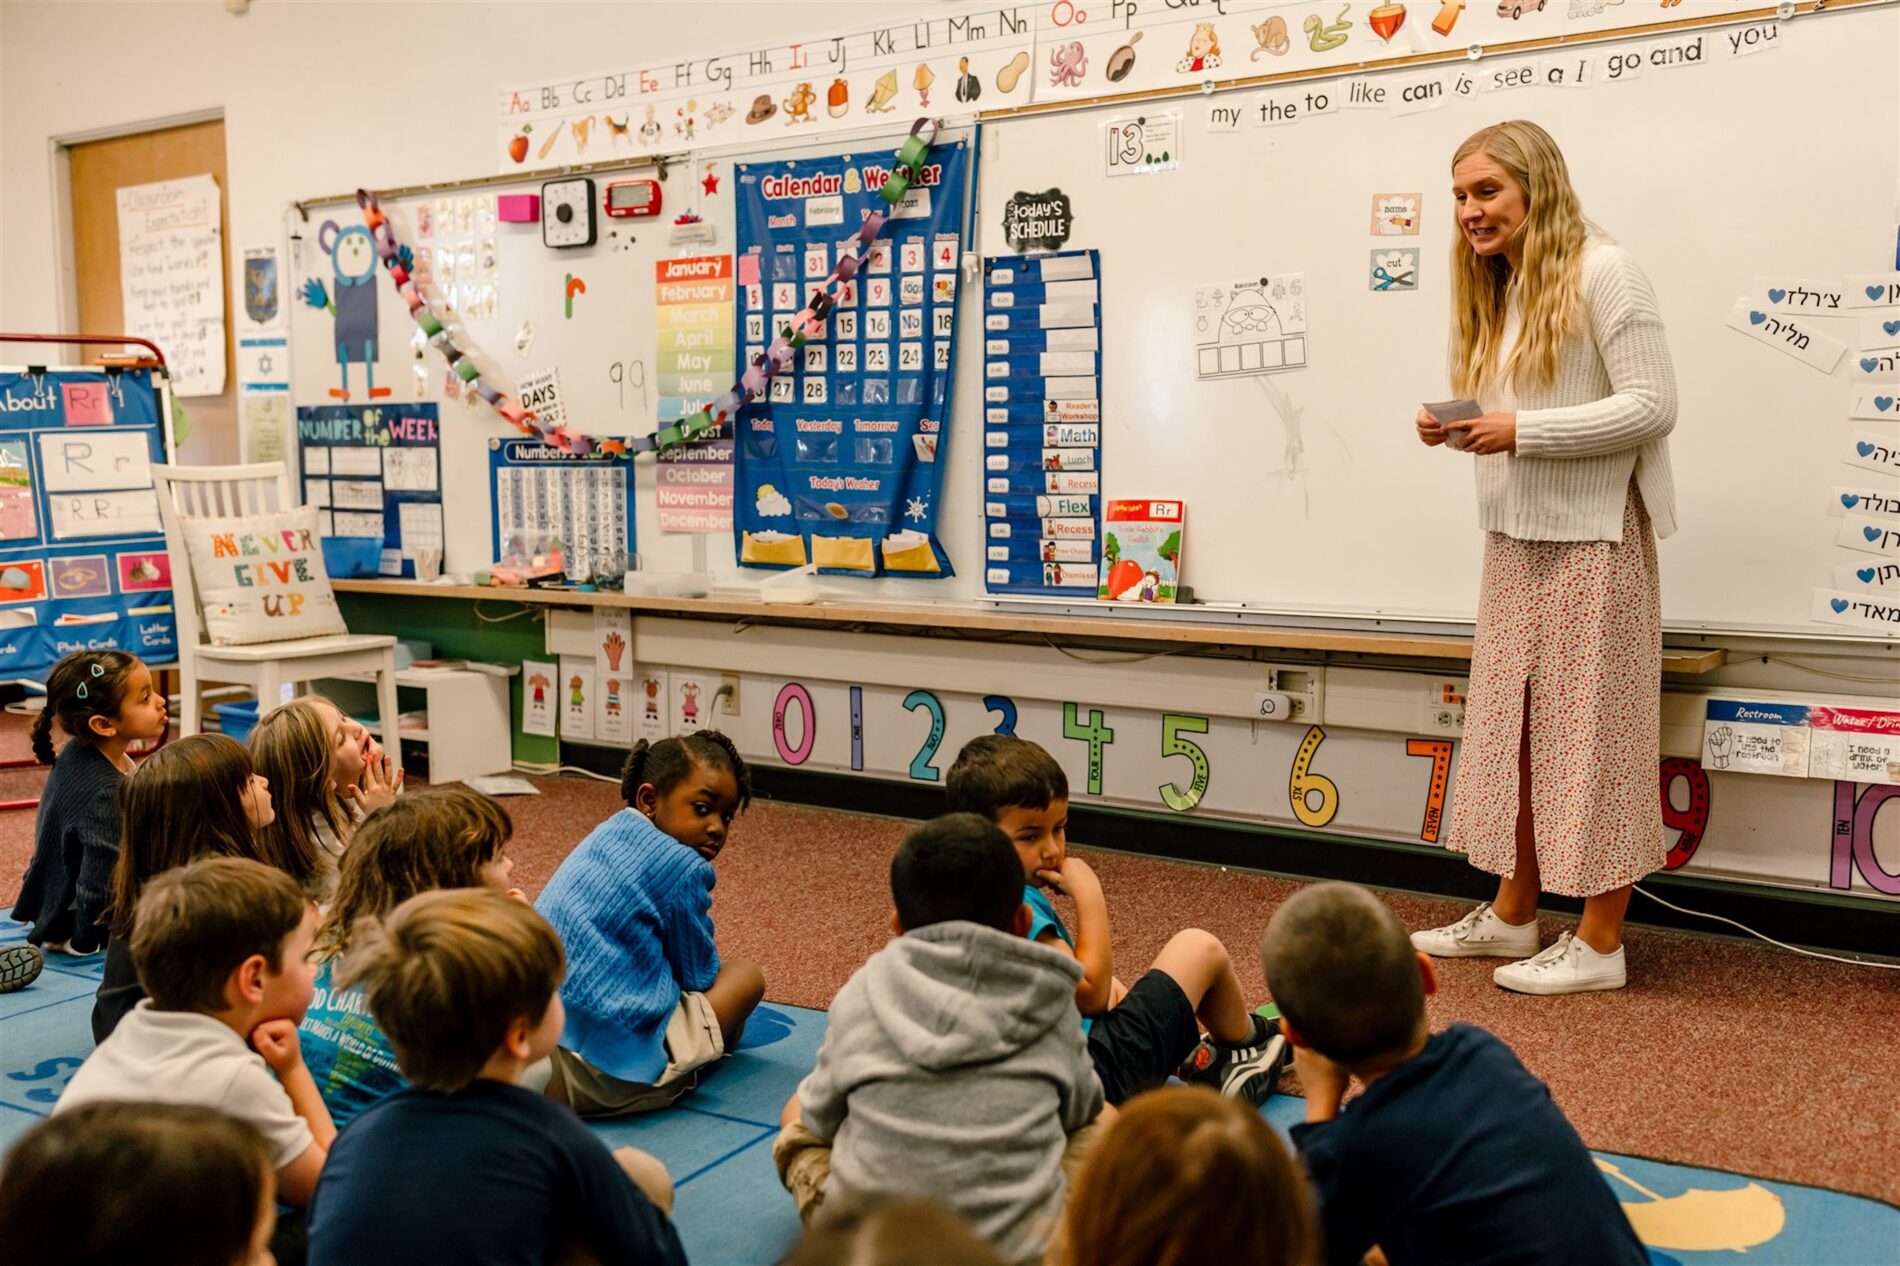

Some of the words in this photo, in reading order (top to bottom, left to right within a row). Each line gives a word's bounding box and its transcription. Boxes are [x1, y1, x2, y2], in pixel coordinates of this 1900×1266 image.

[510, 92, 530, 114] Aa
[541, 87, 559, 110] Bb
[572, 81, 592, 103] Cc
[604, 74, 626, 99] Dd
[639, 70, 659, 94] Ee
[675, 62, 693, 88] Ff
[705, 58, 732, 91] Gg
[749, 50, 772, 76] Hh
[789, 44, 807, 70] Ii
[828, 37, 846, 74] Jj
[873, 28, 896, 56] Kk
[914, 21, 930, 49] Ll
[948, 15, 985, 44] Mm
[1000, 8, 1027, 36] Nn
[1051, 0, 1087, 27] Oo
[1211, 107, 1241, 127] my
[1260, 100, 1297, 122] the
[1305, 92, 1328, 112] to
[1349, 82, 1386, 104] like
[1401, 77, 1443, 102] can
[1455, 72, 1474, 96] is
[1493, 65, 1535, 89] see
[1547, 66, 1563, 84] a
[1575, 59, 1586, 83] I
[1606, 48, 1642, 79] go
[1649, 37, 1703, 66] and
[1728, 23, 1779, 54] you
[1109, 123, 1144, 167] 13
[761, 171, 842, 201] Calendar
[843, 168, 862, 193] &
[768, 213, 797, 229] Month
[1010, 218, 1066, 240] SCHEDULE
[665, 257, 723, 278] January
[809, 256, 824, 272] 31
[874, 252, 884, 268] 2
[908, 250, 917, 266] 3
[940, 247, 951, 263] 4
[1386, 258, 1402, 267] cut
[661, 284, 727, 301] February
[751, 290, 758, 305] 5
[780, 288, 788, 304] 6
[874, 285, 883, 300] 9
[670, 306, 719, 323] March
[750, 321, 761, 336] 12
[840, 318, 853, 334] 15
[870, 318, 885, 333] 16
[938, 314, 952, 330] 18
[675, 328, 714, 349] April
[1764, 318, 1810, 350] מליה
[677, 353, 712, 373] May
[808, 351, 823, 366] 21
[838, 350, 854, 365] 22
[869, 350, 885, 365] 23
[902, 349, 919, 364] 24
[677, 377, 713, 393] June
[773, 382, 791, 397] 27
[806, 383, 823, 398] 28
[522, 384, 556, 409] DAYS
[1066, 402, 1097, 410] Reader's
[299, 418, 362, 440] NUMBER
[364, 427, 391, 447] the
[388, 417, 438, 441] WEEK
[796, 419, 842, 434] Yesterday
[854, 419, 899, 432] Tomorrow
[1060, 428, 1096, 442] Math
[63, 443, 95, 474] R
[1067, 455, 1092, 464] Lunch
[665, 468, 726, 483] October
[809, 476, 844, 491] Today's
[845, 477, 880, 491] Weather
[1068, 479, 1097, 489] Recess
[659, 491, 734, 507] November
[1058, 499, 1088, 513] Flex
[660, 514, 733, 529] December
[1056, 524, 1093, 534] Recess
[210, 528, 317, 559] NEVER
[233, 557, 315, 588] GIVE
[1062, 570, 1097, 579] Dismissal
[262, 592, 305, 618] UP
[139, 623, 170, 635] Letter
[88, 638, 118, 650] Cards
[142, 637, 172, 647] Cards
[1735, 706, 1782, 721] Restroom
[1760, 743, 1776, 753] the
[1857, 745, 1882, 755] need
[1849, 753, 1874, 763] drink
[772, 682, 816, 765] 0
[849, 686, 864, 771] 1
[902, 688, 946, 782] 2
[1063, 701, 1114, 796] 4
[1158, 713, 1210, 812] 5
[1288, 724, 1340, 828] 6
[1406, 738, 1455, 844] 7
[1659, 757, 1710, 870] 9
[1091, 761, 1100, 781] FOUR
[1194, 773, 1206, 792] FIVE
[1292, 786, 1303, 802] SIX
[1425, 806, 1440, 835] SEVEN
